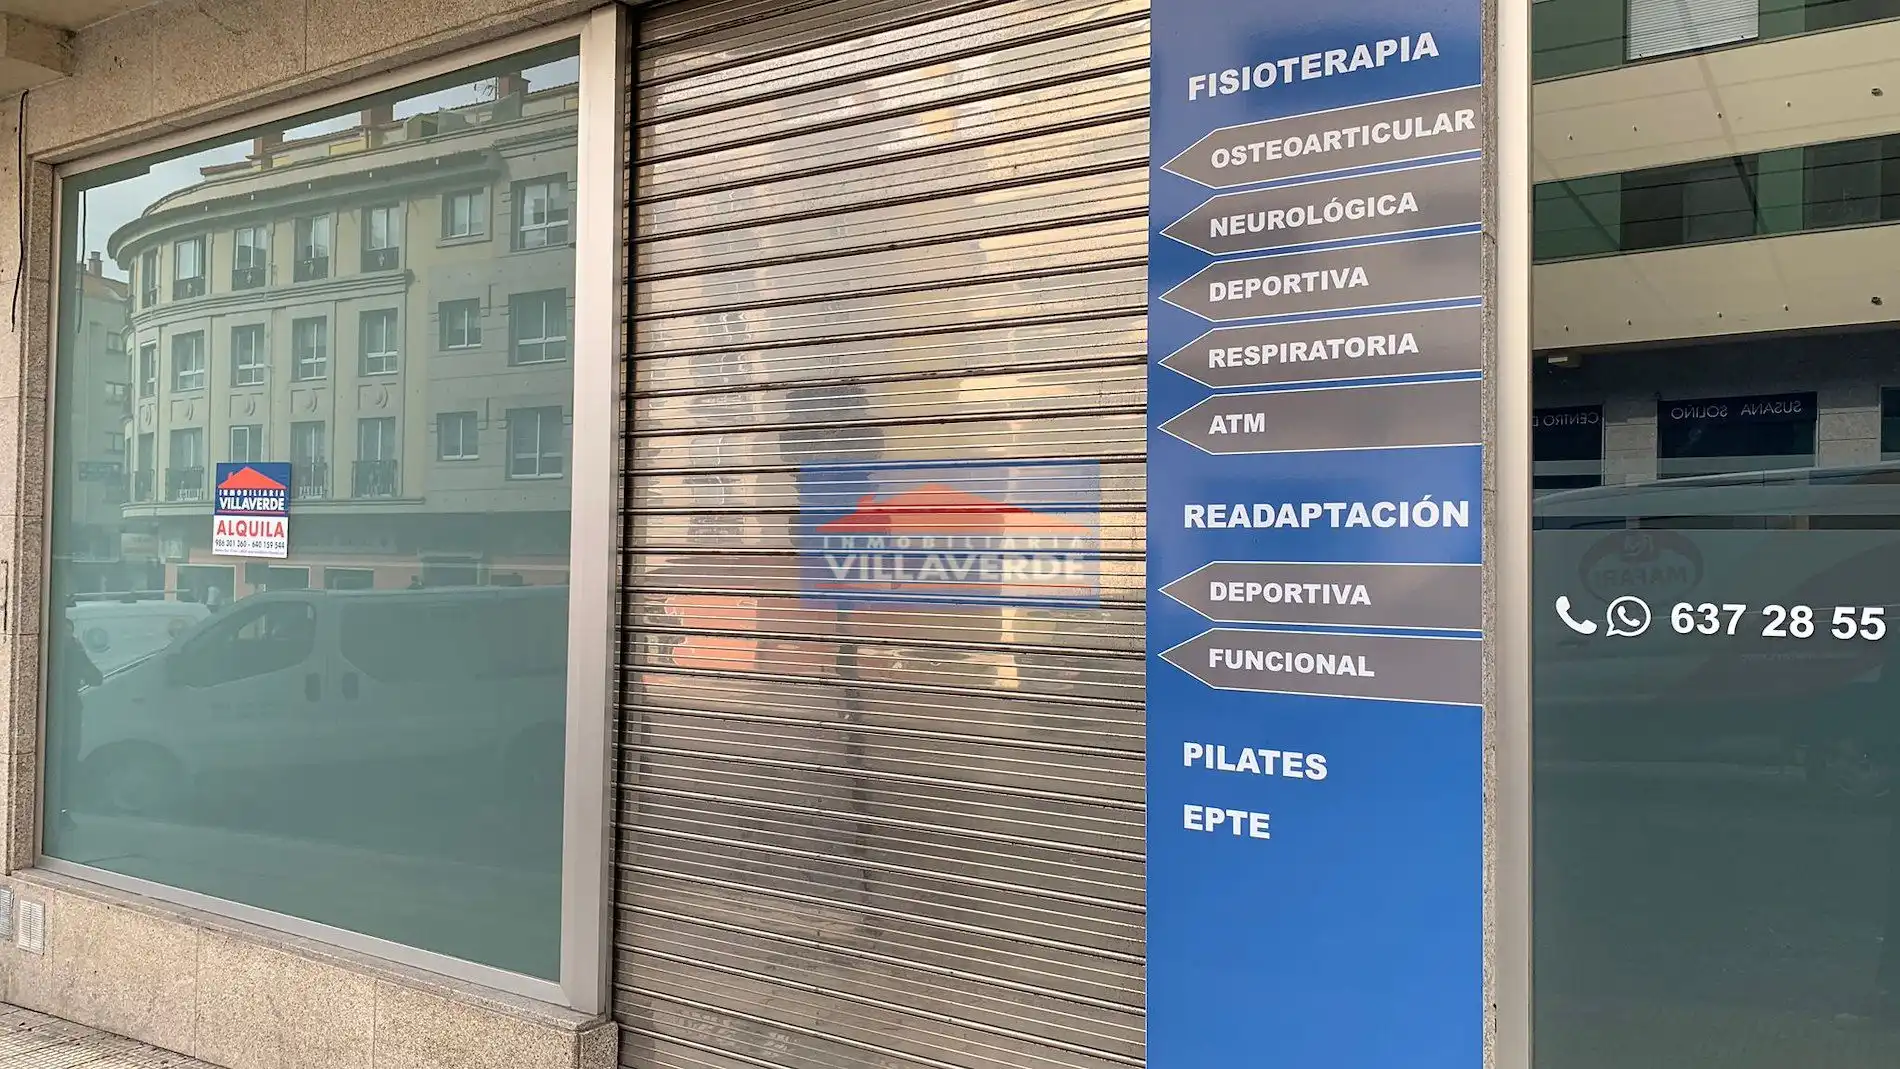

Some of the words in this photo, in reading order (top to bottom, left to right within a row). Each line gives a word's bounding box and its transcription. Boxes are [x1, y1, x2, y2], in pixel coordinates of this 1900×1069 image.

[1188, 31, 1440, 101] FISIOTERAPIA
[1210, 108, 1476, 169] OSTEOARTICULAR
[1209, 191, 1419, 238] NEUROLÓGICA
[1208, 266, 1369, 303] DEPORTIVA
[1208, 332, 1419, 369] RESPIRATORIA
[1208, 412, 1266, 435] ATM
[219, 497, 285, 510] VILLAVERDE
[1184, 494, 1469, 529] READAPTACIÓN
[216, 520, 284, 538] ALQUILA
[1210, 581, 1372, 606] DEPORTIVA
[1670, 602, 1747, 635] 637
[1761, 604, 1815, 638] 28
[1831, 606, 1887, 641] 55
[1208, 648, 1375, 677] FUNCIONAL
[1183, 742, 1328, 781] PILATES
[1183, 804, 1271, 840] EPTE
